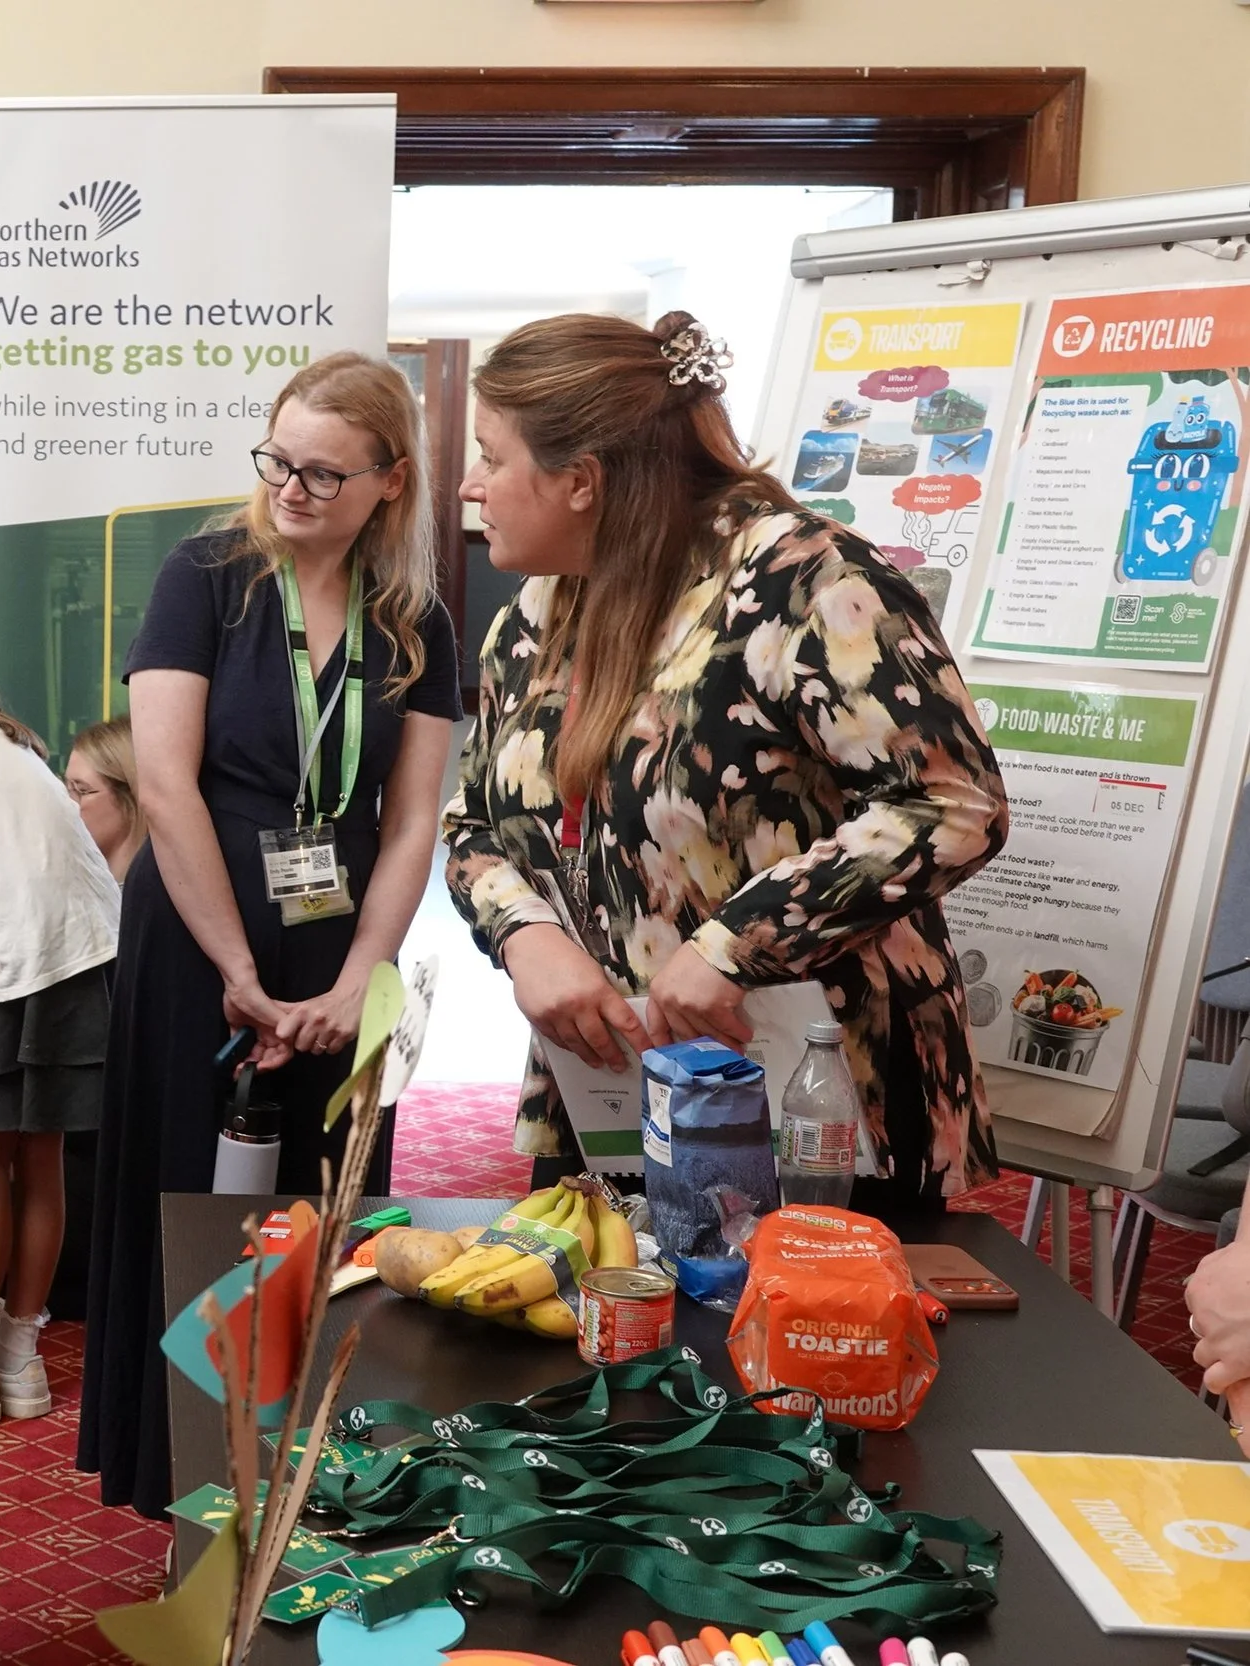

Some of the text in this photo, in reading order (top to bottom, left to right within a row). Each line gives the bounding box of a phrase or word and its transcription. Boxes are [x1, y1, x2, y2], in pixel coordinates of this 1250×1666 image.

[28, 244, 140, 267] Networks
[50, 303, 102, 326] are
[114, 293, 173, 326] the
[185, 293, 334, 327] network
[869, 322, 965, 353] TRANSPORT
[1100, 316, 1214, 353] RECYCLING
[122, 343, 184, 375] gas
[193, 339, 233, 367] to
[243, 344, 310, 375] you
[888, 374, 914, 382] What is
[880, 385, 918, 394] Transport?
[55, 395, 167, 424] investing
[176, 396, 197, 418] in
[206, 402, 218, 418] a
[227, 396, 272, 418] clea
[1041, 410, 1076, 418] Recycling
[34, 438, 128, 461] greener
[136, 434, 214, 456] future
[918, 482, 951, 493] Negative
[914, 495, 950, 504] Impacts?
[1144, 605, 1164, 613] Scan
[1000, 708, 1146, 742] FOOD WASTE & ME
[1012, 763, 1033, 771] when
[1034, 763, 1052, 772] food
[1053, 765, 1059, 773] is
[1060, 767, 1074, 775] not
[1075, 769, 1098, 777] eaten
[1100, 770, 1113, 779] and
[1114, 772, 1121, 780] is
[1123, 773, 1150, 782] thrown
[1019, 798, 1042, 807] food?
[1111, 801, 1144, 813] 05 DEC
[1014, 820, 1034, 829] don't
[1050, 826, 1059, 834] up
[1060, 826, 1078, 835] food
[1079, 828, 1105, 839] before
[1106, 831, 1112, 839] it
[1113, 833, 1132, 842] goes
[1058, 816, 1078, 825] cook
[1078, 820, 1099, 828] more
[1100, 821, 1117, 830] than
[1008, 855, 1026, 864] food
[973, 873, 994, 881] pacts
[995, 876, 1023, 886] climate
[1000, 868, 1037, 879] resources
[1038, 872, 1051, 881] like
[1052, 876, 1075, 885] water
[1076, 878, 1090, 886] and
[1091, 881, 1120, 892] energy,
[943, 904, 961, 912] astes
[949, 891, 961, 899] not
[962, 893, 980, 902] have
[982, 896, 1009, 908] enough
[1005, 891, 1032, 901] people
[1033, 895, 1043, 903] go
[1044, 896, 1071, 908] hungry
[1071, 901, 1102, 911] because
[1103, 905, 1120, 916] they
[952, 919, 974, 928] waste
[974, 921, 995, 931] often
[996, 926, 1013, 935] ends
[1014, 929, 1024, 937] up
[1025, 929, 1032, 937] in
[1062, 937, 1085, 946] which
[1086, 940, 1109, 950] harms
[791, 1319, 883, 1338] ORIGINAL
[784, 1332, 889, 1356] TOASTIE
[770, 1374, 898, 1417] Warurtons
[1071, 1499, 1175, 1576] TRANSPORT
